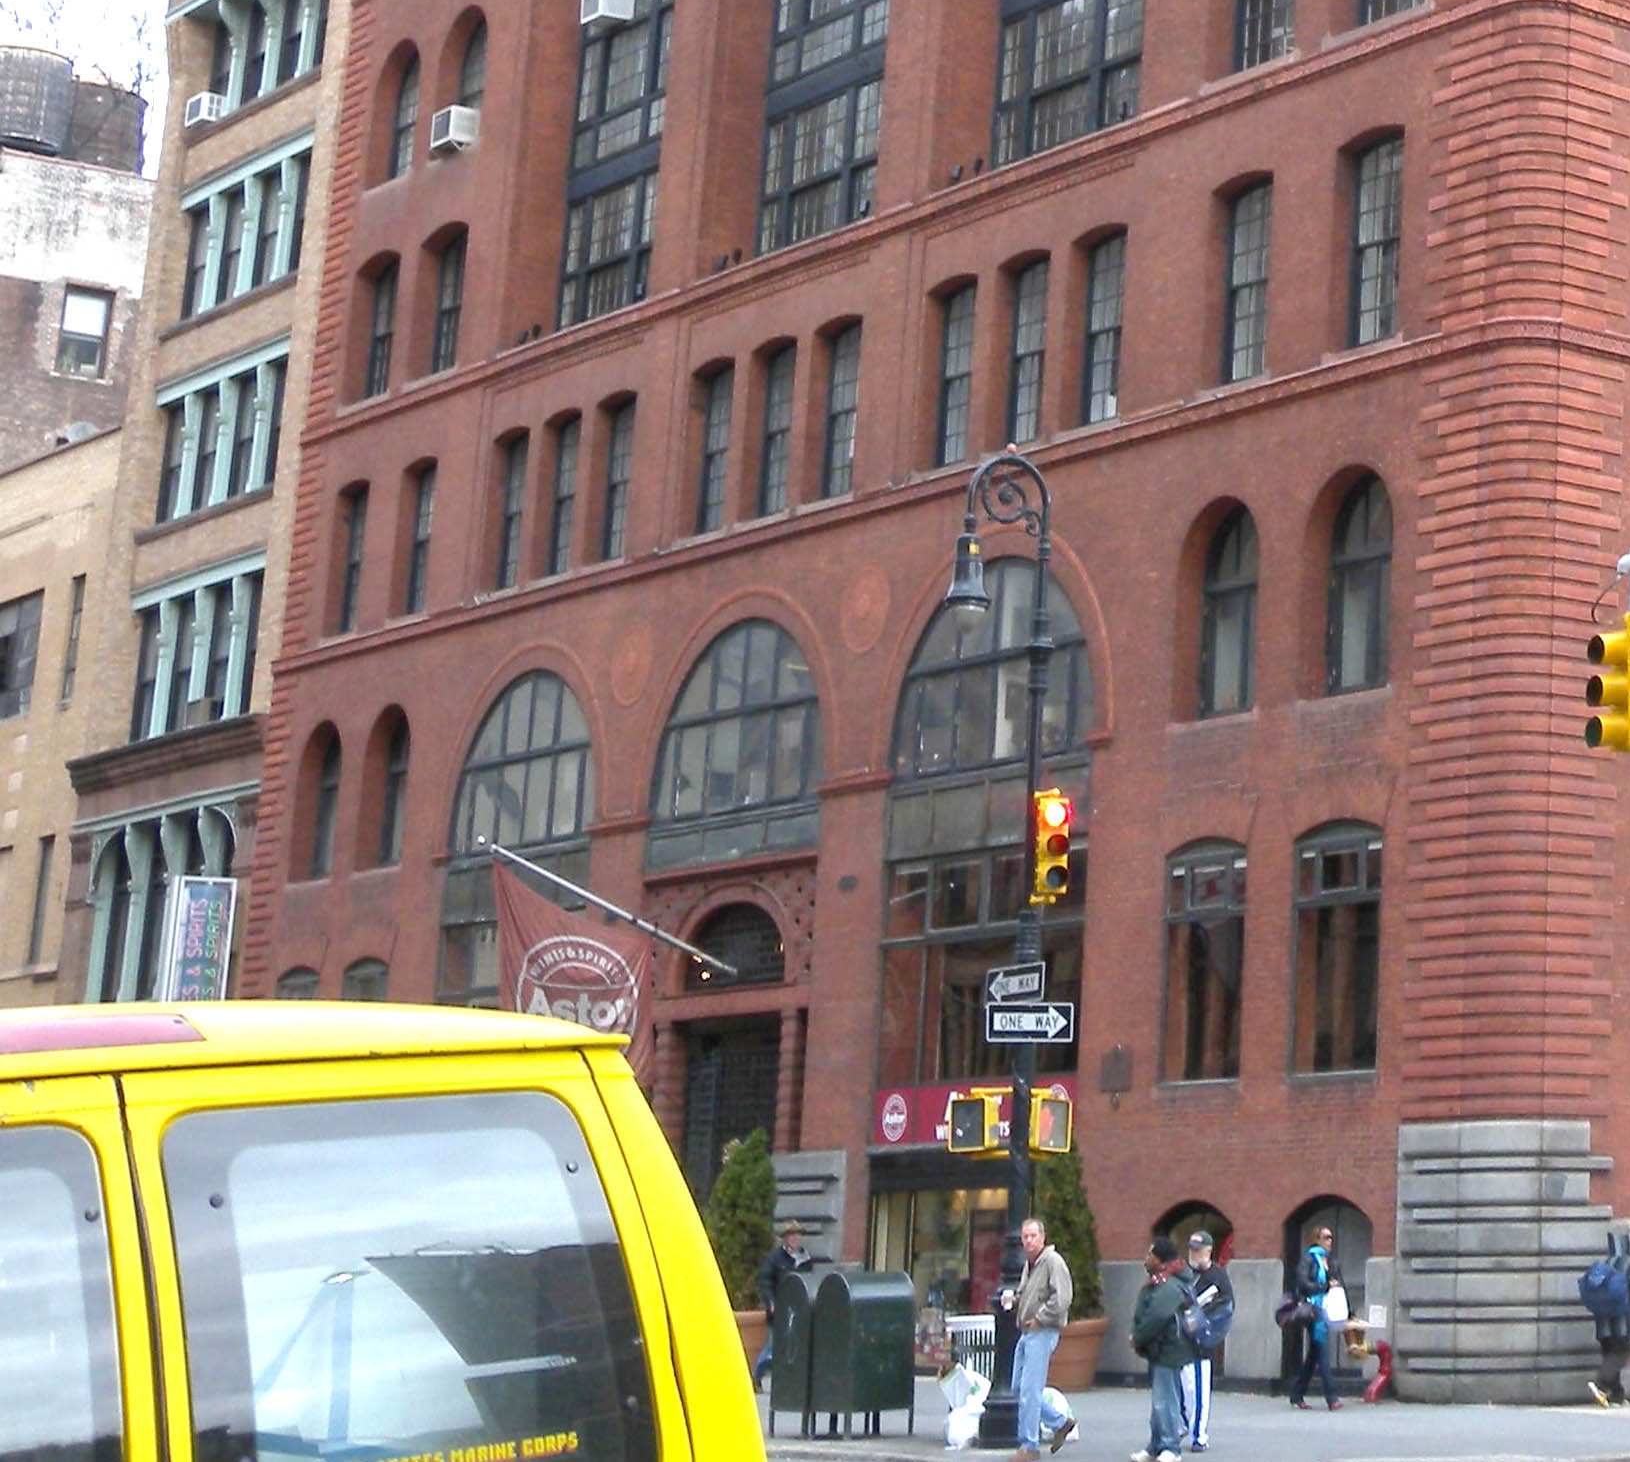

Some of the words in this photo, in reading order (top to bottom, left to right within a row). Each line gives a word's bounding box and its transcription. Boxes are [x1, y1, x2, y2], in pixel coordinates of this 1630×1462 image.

[1000, 1015, 1023, 1030] ONE
[1034, 1014, 1060, 1030] WAY
[449, 1441, 517, 1462] MARINE
[521, 1431, 579, 1457] CORPS
